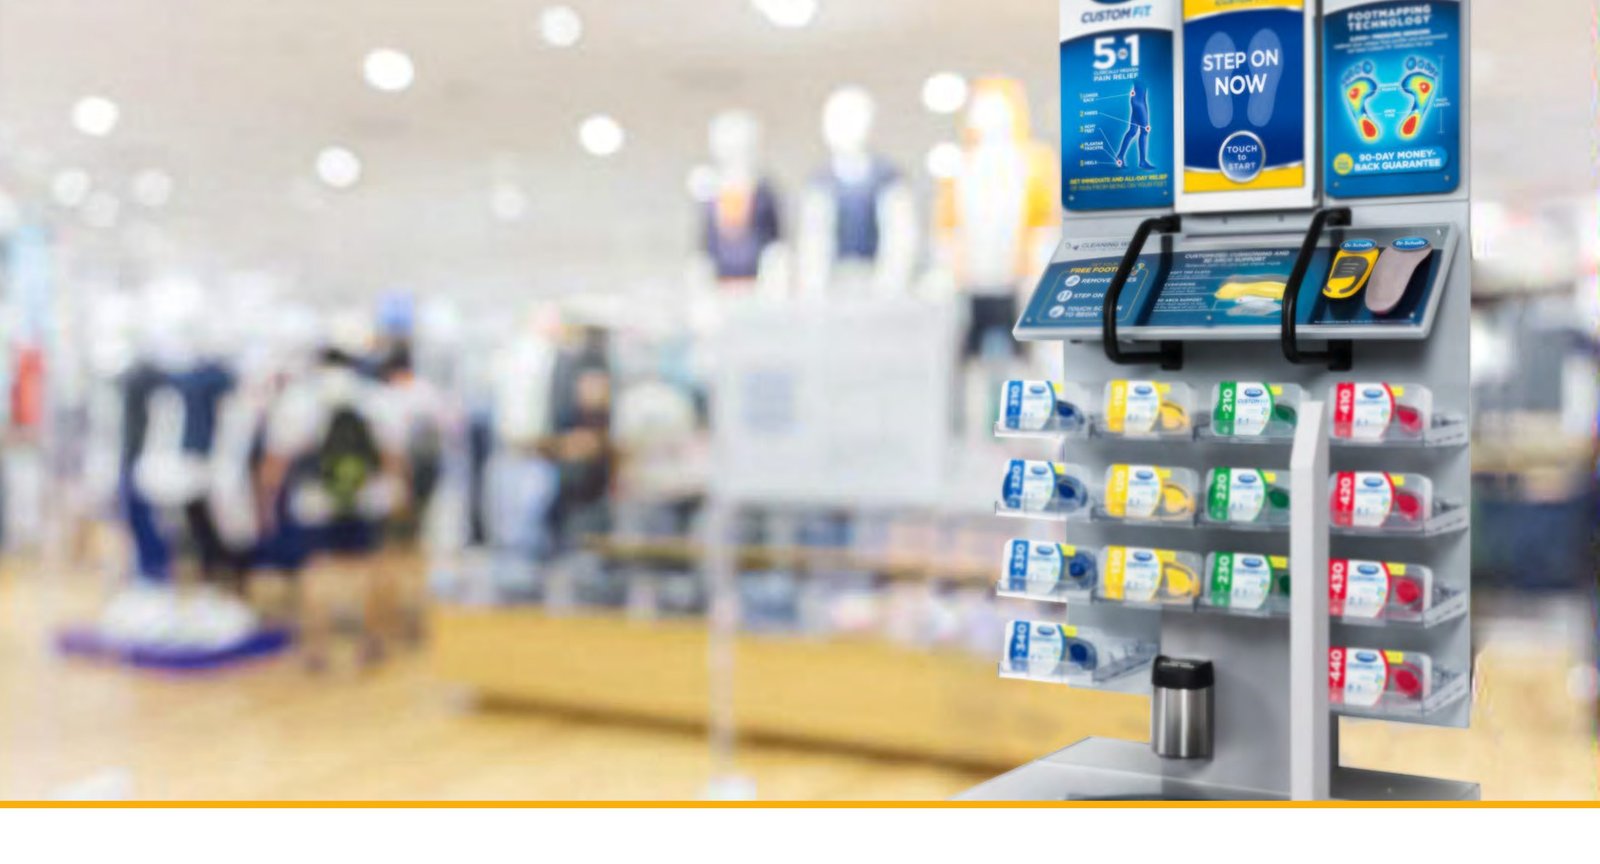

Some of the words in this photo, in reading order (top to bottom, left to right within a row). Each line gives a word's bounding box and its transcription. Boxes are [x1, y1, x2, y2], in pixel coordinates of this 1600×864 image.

[1081, 8, 1131, 23] CUSTOM
[1132, 5, 1152, 17] FIT
[1347, 4, 1431, 20] FOOTMAPPING
[1347, 15, 1431, 31] TECHNOLOGY
[1093, 36, 1117, 69] 5
[1125, 34, 1139, 67] 1
[1203, 52, 1246, 71] STEP
[1251, 49, 1279, 67] ON
[1214, 74, 1267, 96] NOW
[1227, 145, 1258, 153] TOUCH
[1360, 152, 1395, 162] 90-DAY
[1397, 149, 1436, 159] MONEY-
[1228, 162, 1256, 171] START
[1354, 163, 1380, 172] BACK
[1382, 158, 1441, 170] GUARANTEE
[1222, 388, 1233, 412] 210
[1339, 389, 1351, 414] 410
[1216, 474, 1227, 500] 220
[1340, 478, 1352, 504] 420
[1217, 555, 1229, 583] 230
[1331, 563, 1344, 593] 430
[1331, 651, 1342, 682] 440
